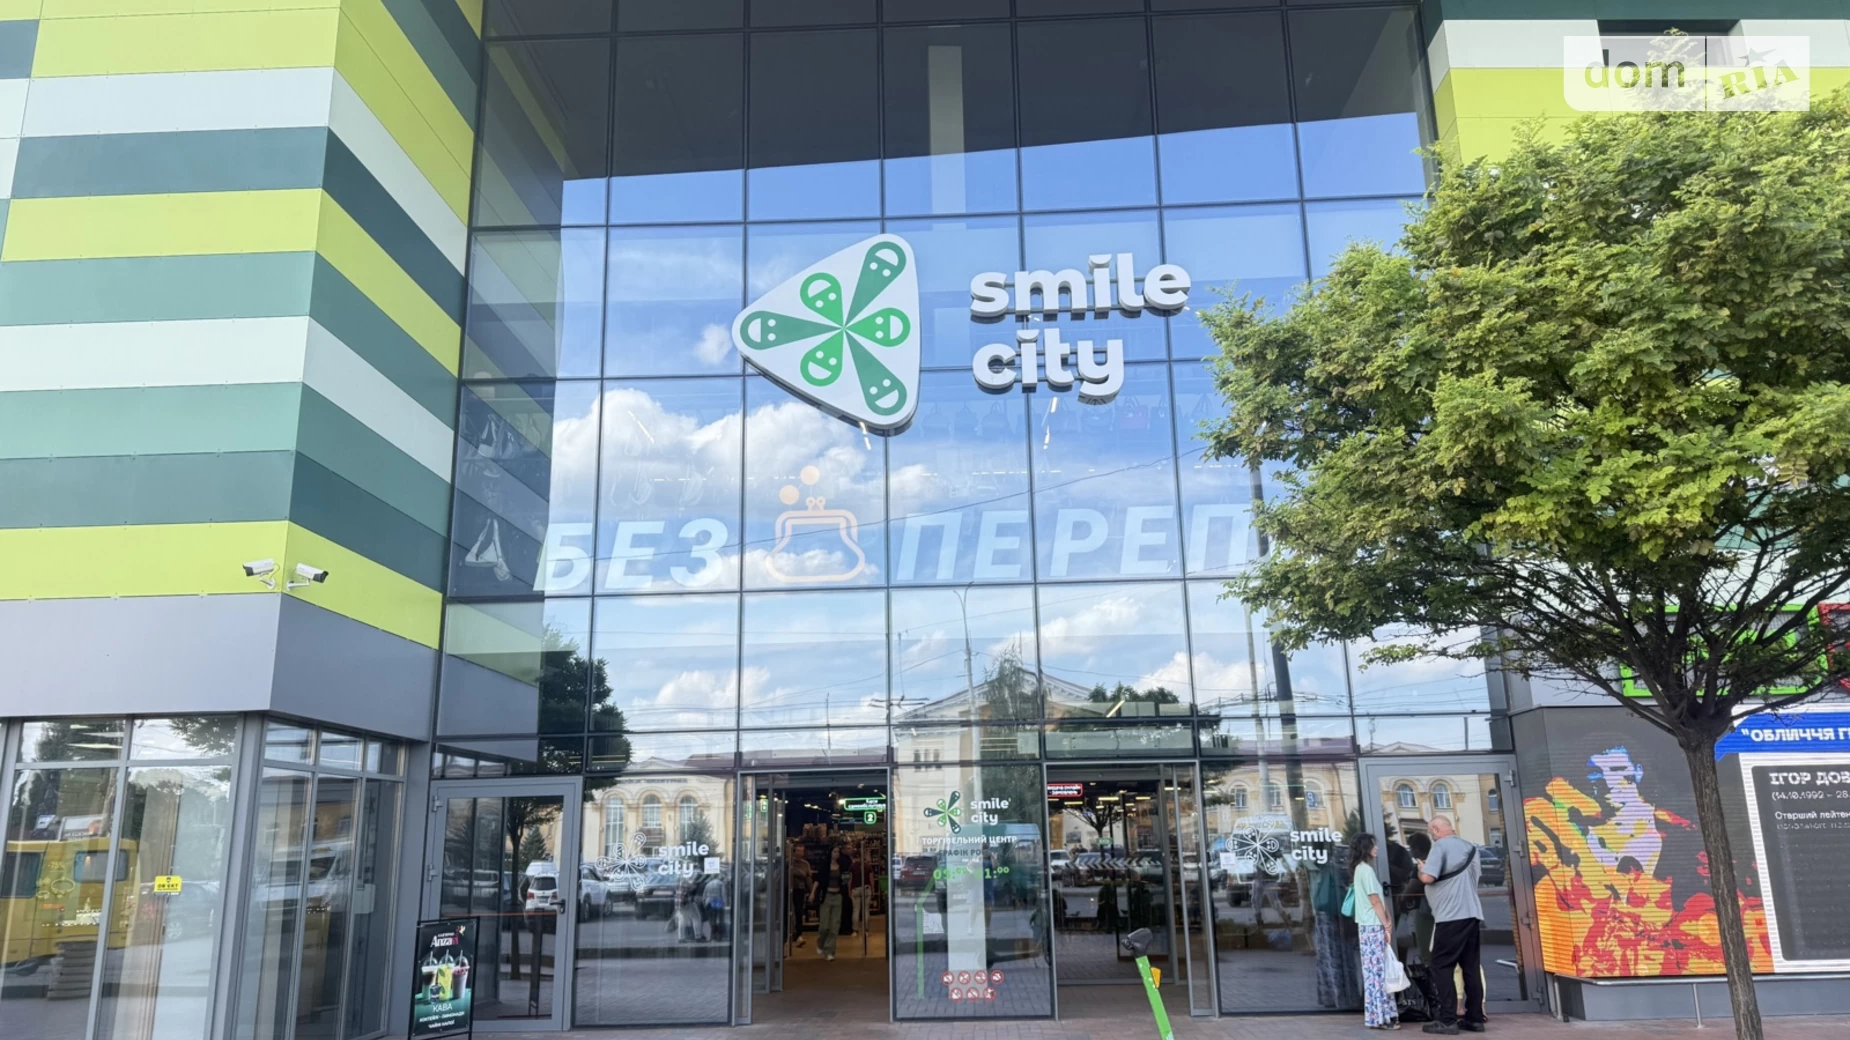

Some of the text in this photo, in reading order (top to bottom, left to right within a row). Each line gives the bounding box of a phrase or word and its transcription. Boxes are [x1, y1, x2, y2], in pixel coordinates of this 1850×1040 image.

[970, 252, 1192, 320] smile
[972, 328, 1125, 401] city
[533, 517, 729, 592] БЕЗ
[1769, 772, 1811, 785] ІГОР
[970, 797, 1009, 809] smile
[970, 811, 999, 826] city
[989, 835, 1018, 845] ЦЕНТР
[1290, 827, 1343, 843] smile
[658, 841, 710, 858] smile
[1292, 846, 1329, 864] city
[657, 861, 695, 878] city
[432, 1003, 453, 1012] КАВА
